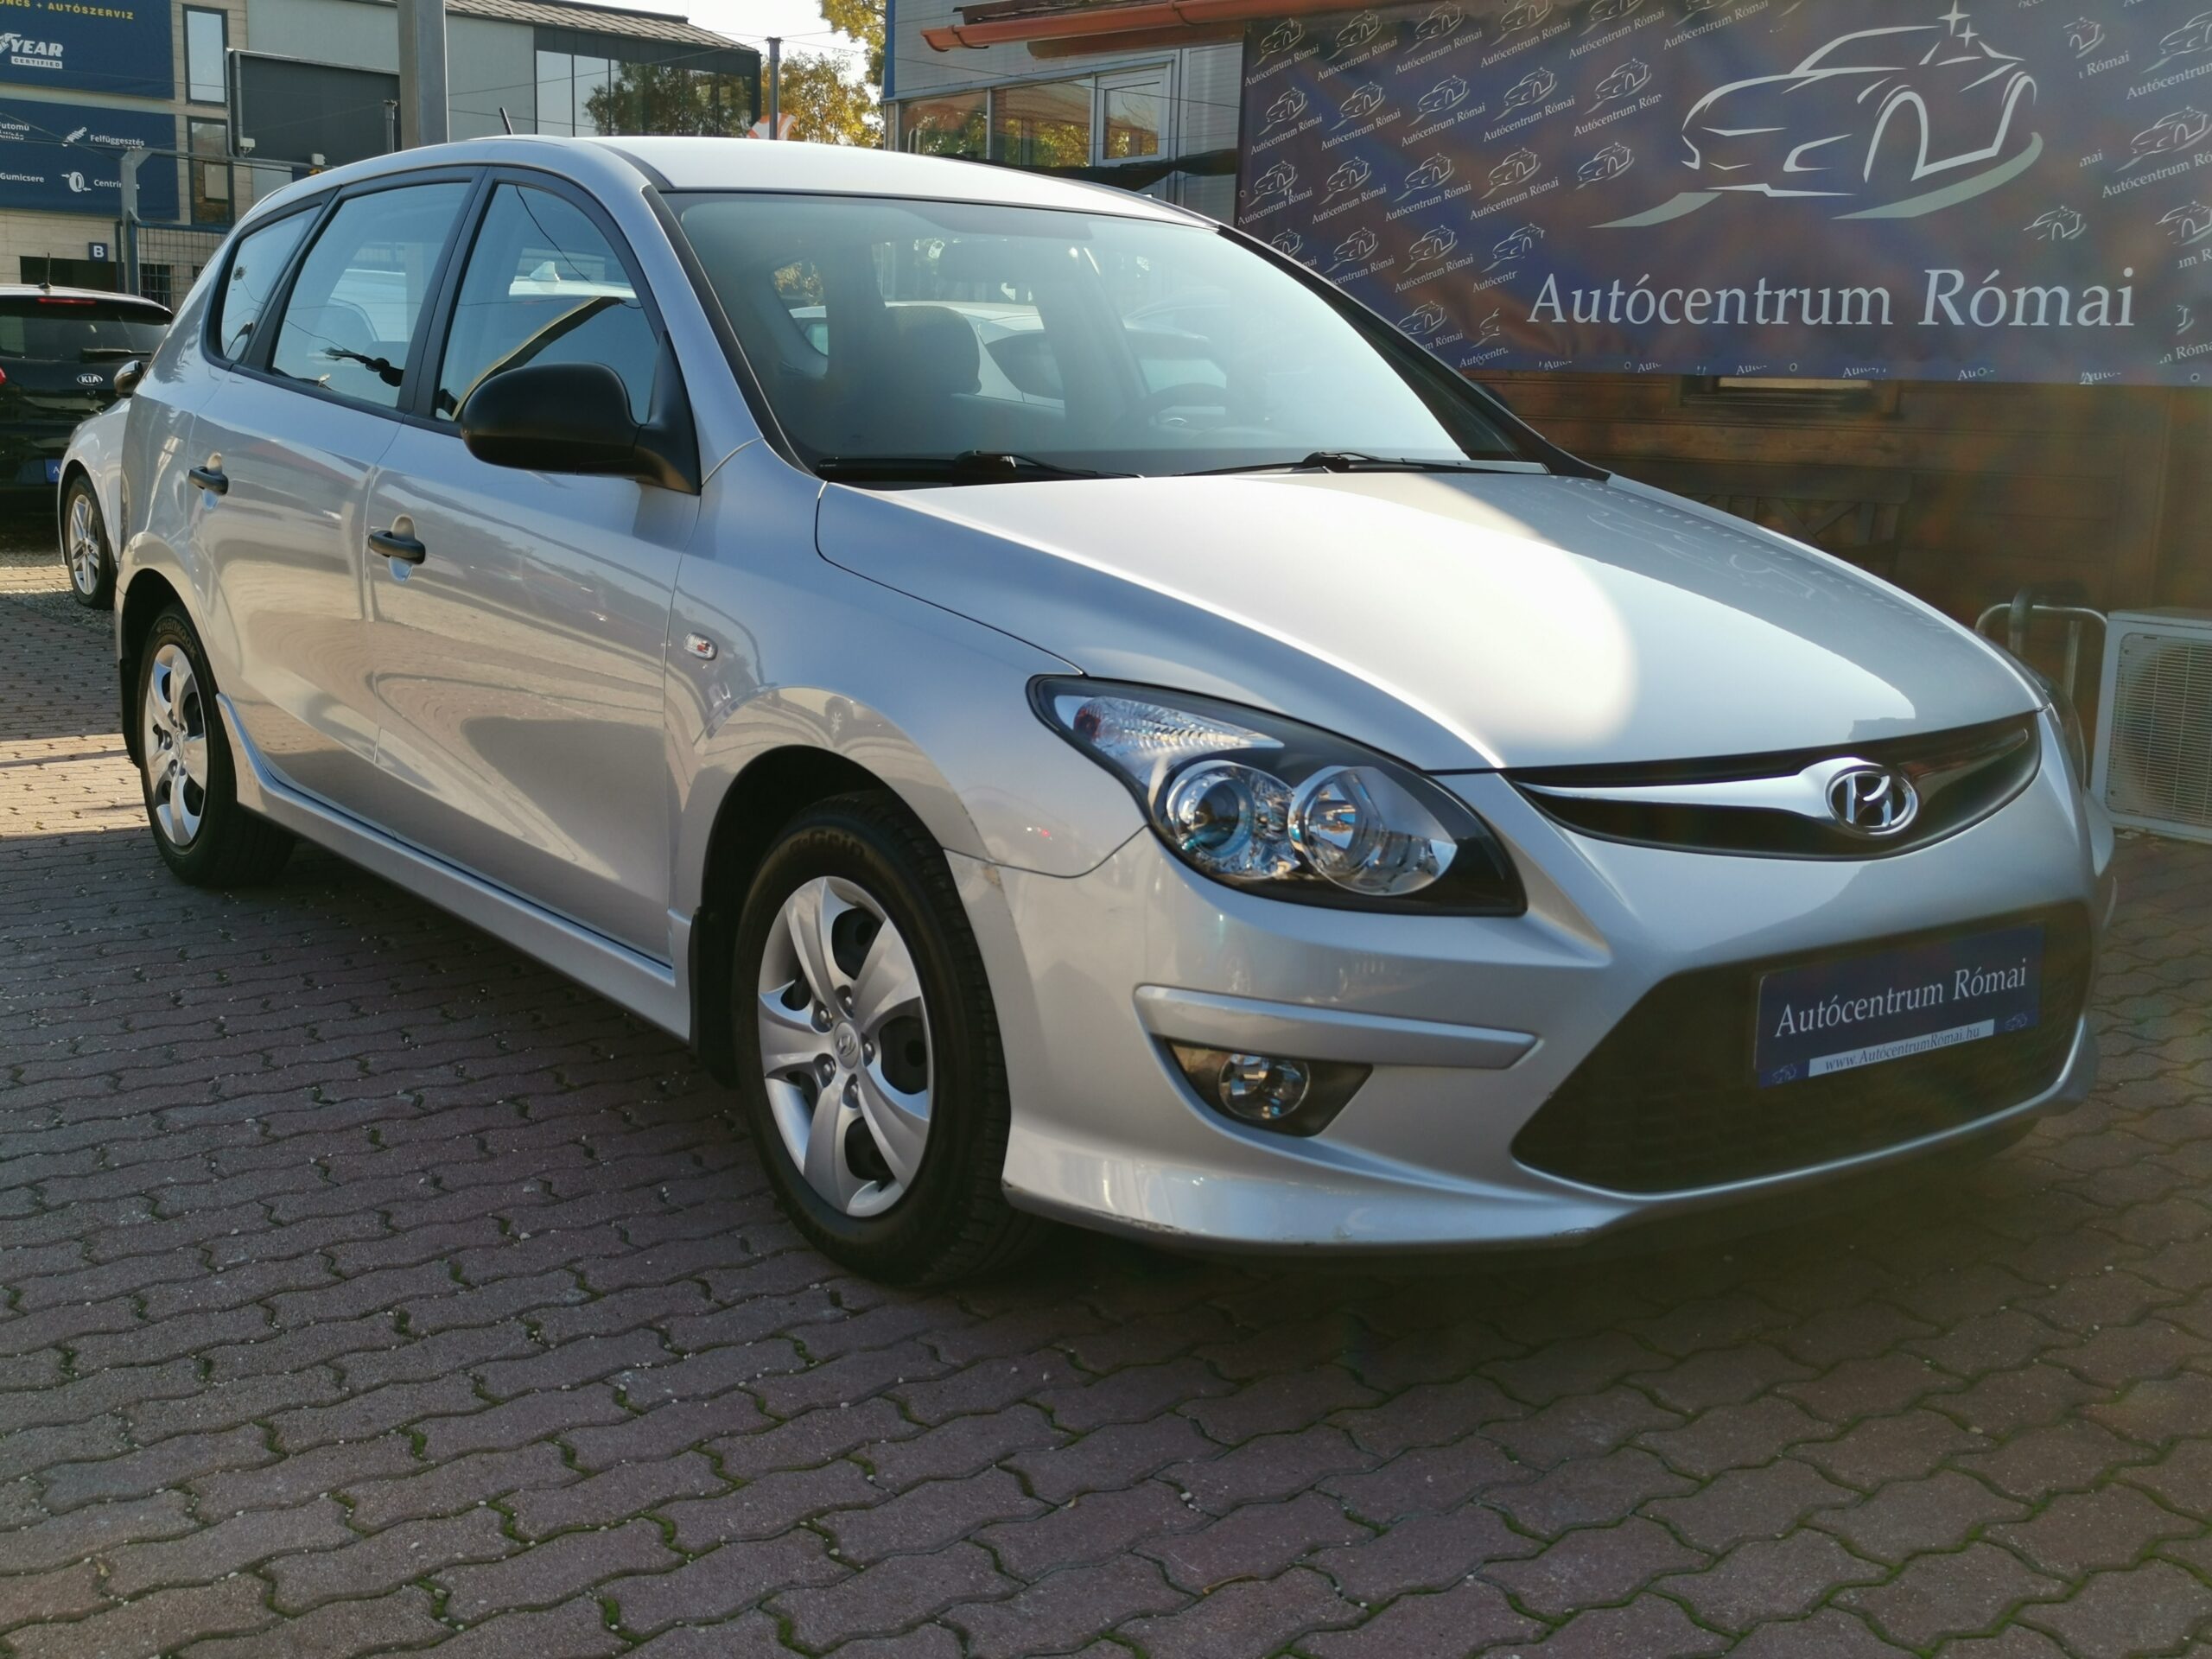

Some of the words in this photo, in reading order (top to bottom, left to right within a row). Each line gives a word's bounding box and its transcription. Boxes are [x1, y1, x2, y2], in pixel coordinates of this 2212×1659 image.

[48, 3, 134, 19] AUTÓSZERVIZ
[1663, 16, 1732, 49] Autócentrum
[1735, 0, 1768, 20] Római
[1395, 46, 1452, 74] Autócentrum
[1454, 29, 1483, 48] Római
[1481, 35, 1539, 67] Autócentrum
[1541, 18, 1571, 40] Római
[1569, 24, 1631, 60] Autócentrum
[1634, 8, 1665, 30] Római
[14, 58, 60, 67] CERTIFIED
[1318, 52, 1370, 81] Autócentrum
[1371, 36, 1397, 56] Római
[2087, 50, 2130, 76] Római
[1251, 128, 1297, 155] Autócentrum
[1299, 115, 1322, 131] Római
[1321, 121, 1374, 150] Autócentrum
[1376, 108, 1401, 126] Római
[1402, 116, 1456, 147] Autócentrum
[1458, 103, 1485, 121] Római
[1484, 111, 1541, 142] Autócentrum
[1545, 95, 1575, 116] Római
[1574, 104, 1637, 137] Autócentrum
[90, 134, 145, 146] Felfüggesztés
[1470, 193, 1528, 219] Autócentrum
[1529, 177, 1559, 195] Római
[2102, 162, 2190, 198] Autócentrum
[1237, 199, 1287, 226] Autócentrum
[1288, 188, 1313, 206] Római
[1313, 197, 1358, 224] Autócentrum
[1360, 184, 1387, 204] Római
[1385, 193, 1441, 221] Autócentrum
[1444, 181, 1471, 200] Római
[93, 245, 105, 257] B
[1370, 255, 1395, 273] Római
[1395, 269, 1445, 293] Autócentrum
[1446, 254, 1473, 271] Római
[1527, 273, 1893, 325] Autócentrum
[1917, 267, 2134, 327] Római
[1435, 331, 1463, 348] Római
[1775, 982, 1943, 1038] Autócentrum
[1953, 957, 2026, 1001] Római
[1825, 1027, 1980, 1071] www.AutócentrumRómai.hu
